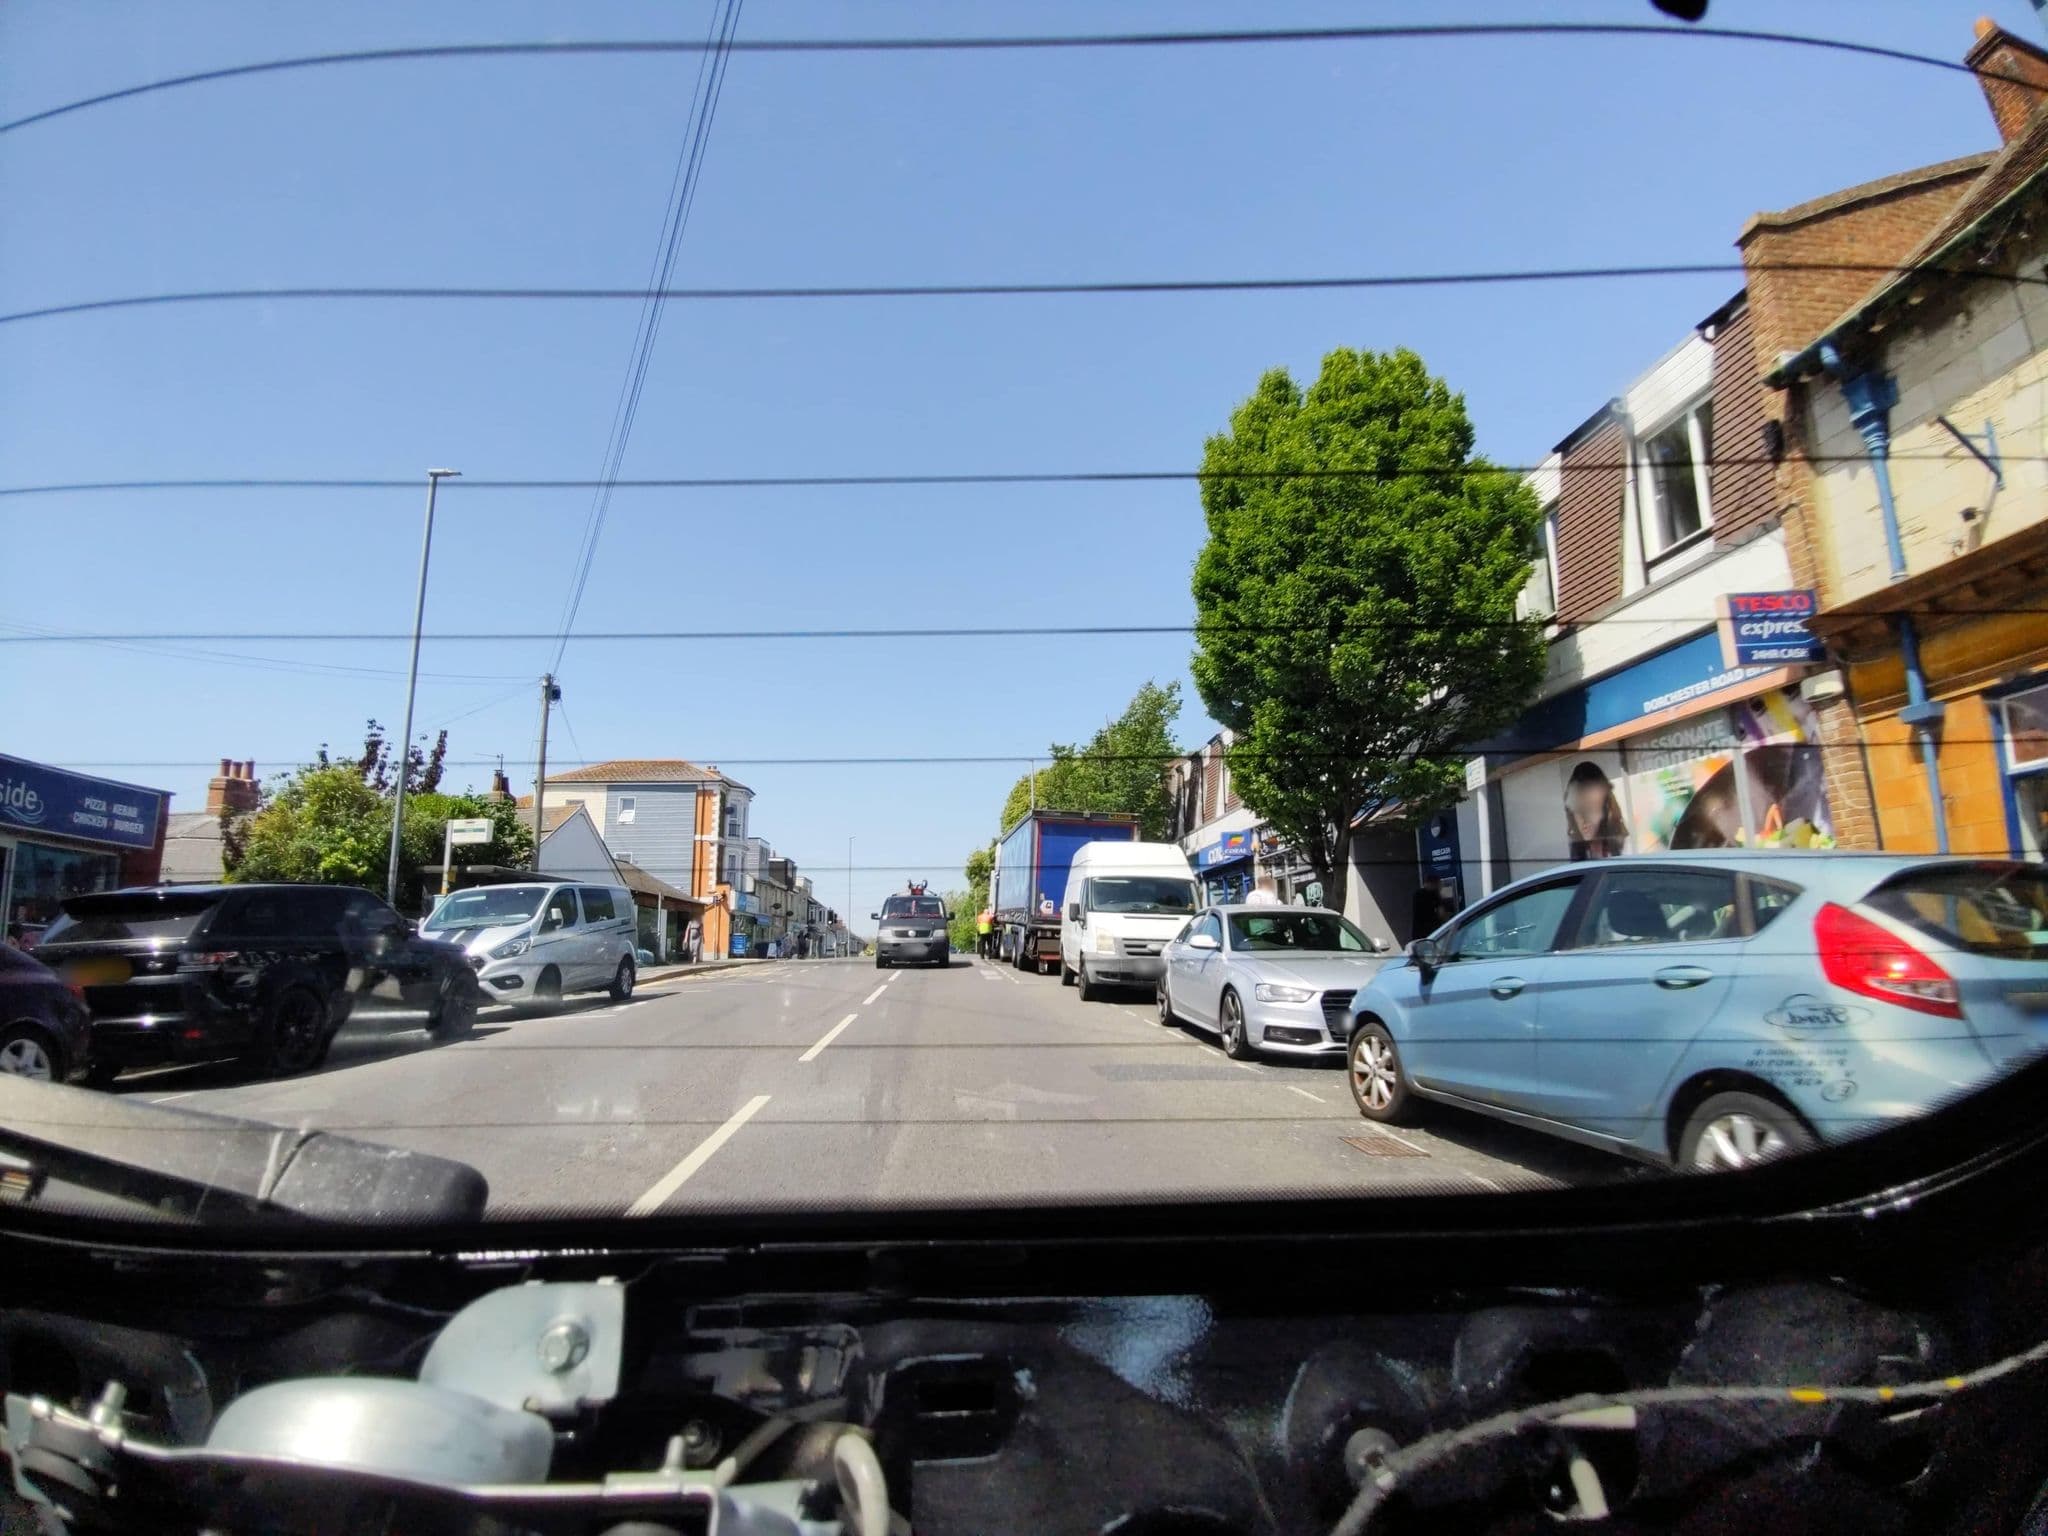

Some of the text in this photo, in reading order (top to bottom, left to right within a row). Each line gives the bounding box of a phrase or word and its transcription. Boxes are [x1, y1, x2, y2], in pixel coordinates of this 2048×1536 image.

[1734, 594, 1810, 612] TESCO
[1740, 619, 1809, 639] expres
[1643, 680, 1711, 713] DORCHESTER
[1711, 667, 1745, 689] ROAD
[84, 797, 107, 812] PIZZA
[73, 811, 144, 835] CHICKEN BURGER
